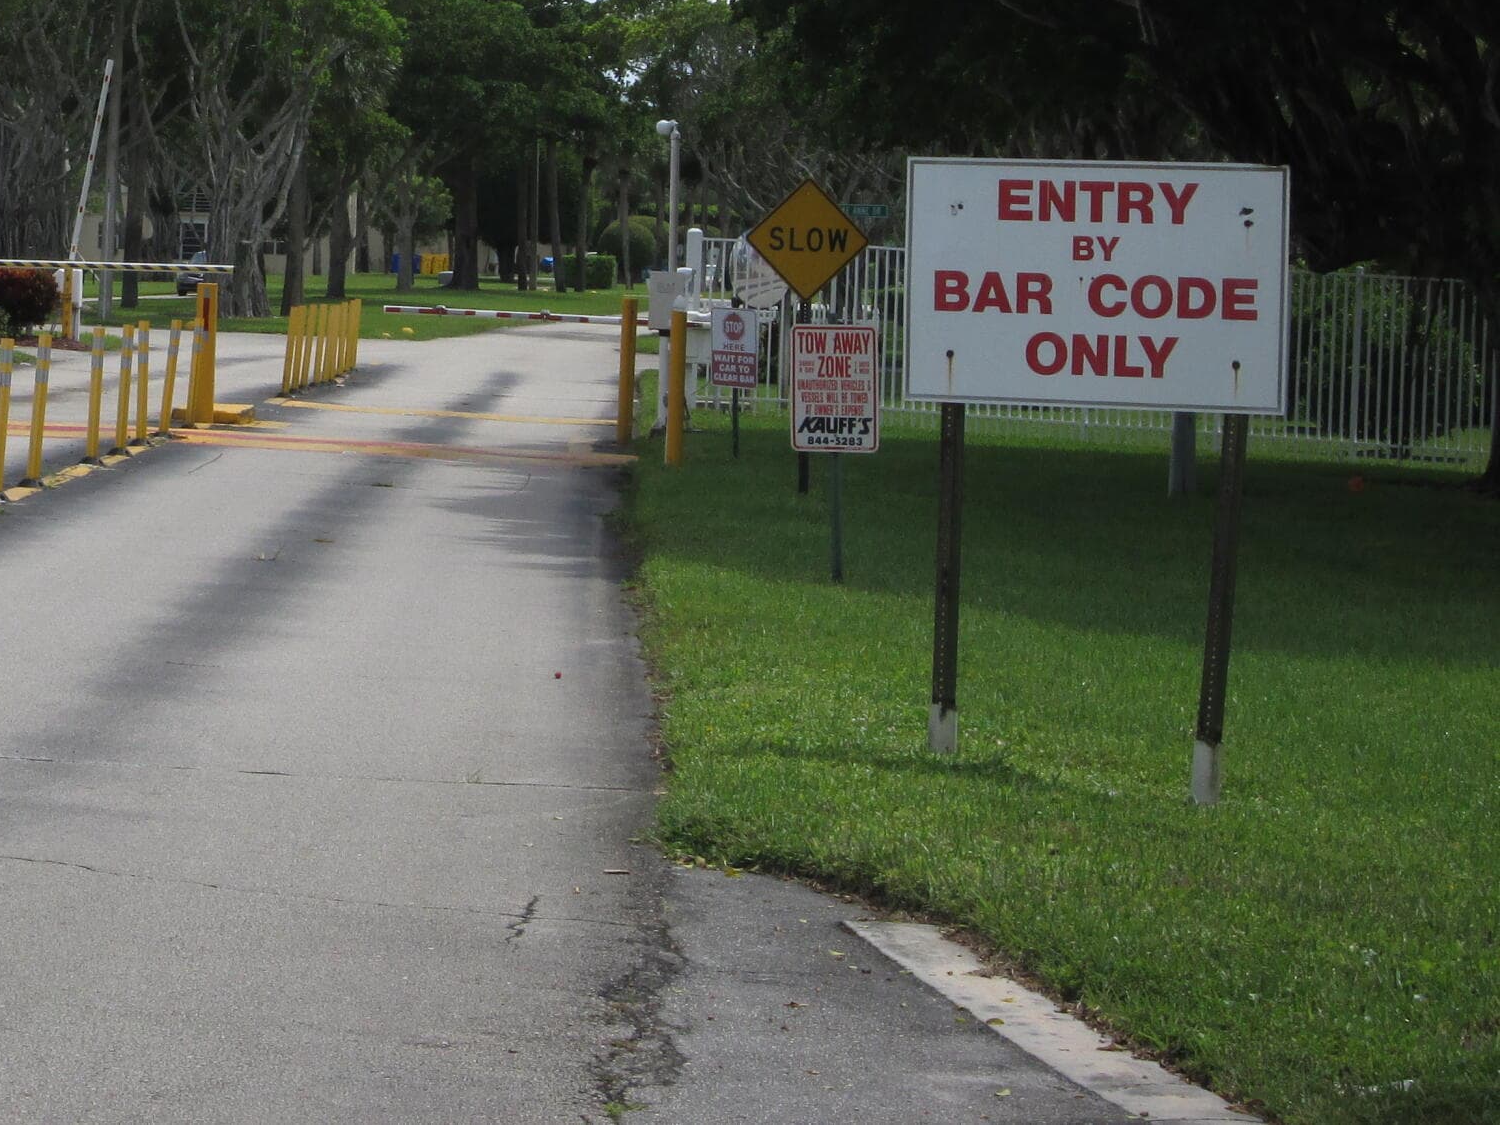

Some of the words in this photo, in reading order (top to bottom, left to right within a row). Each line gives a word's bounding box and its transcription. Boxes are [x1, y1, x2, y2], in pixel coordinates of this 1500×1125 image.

[998, 179, 1199, 225] ENTRY
[769, 226, 848, 253] SLOW
[1072, 235, 1121, 262] BY
[934, 270, 1053, 315] BAR
[1088, 273, 1258, 321] CODE
[725, 321, 743, 333] STOP
[724, 343, 745, 351] HERE
[797, 332, 827, 354] TOW
[833, 332, 870, 354] AWAY
[714, 354, 735, 363] WAIT
[738, 356, 754, 364] FOR
[1025, 332, 1179, 379] ONLY
[719, 364, 736, 372] CAR
[739, 365, 750, 373] TO
[818, 356, 851, 377] ZONE
[714, 373, 737, 381] CLEAR
[739, 375, 754, 383] BAR
[797, 380, 838, 390] UNAUTHORIZED
[841, 380, 865, 391] VEHICLES
[801, 392, 823, 403] VESSELS
[827, 392, 839, 403] WILL
[841, 392, 848, 403] BE
[851, 393, 868, 403] TOWED
[798, 416, 873, 435] KAUFF'S
[808, 436, 863, 446] 844-5283
